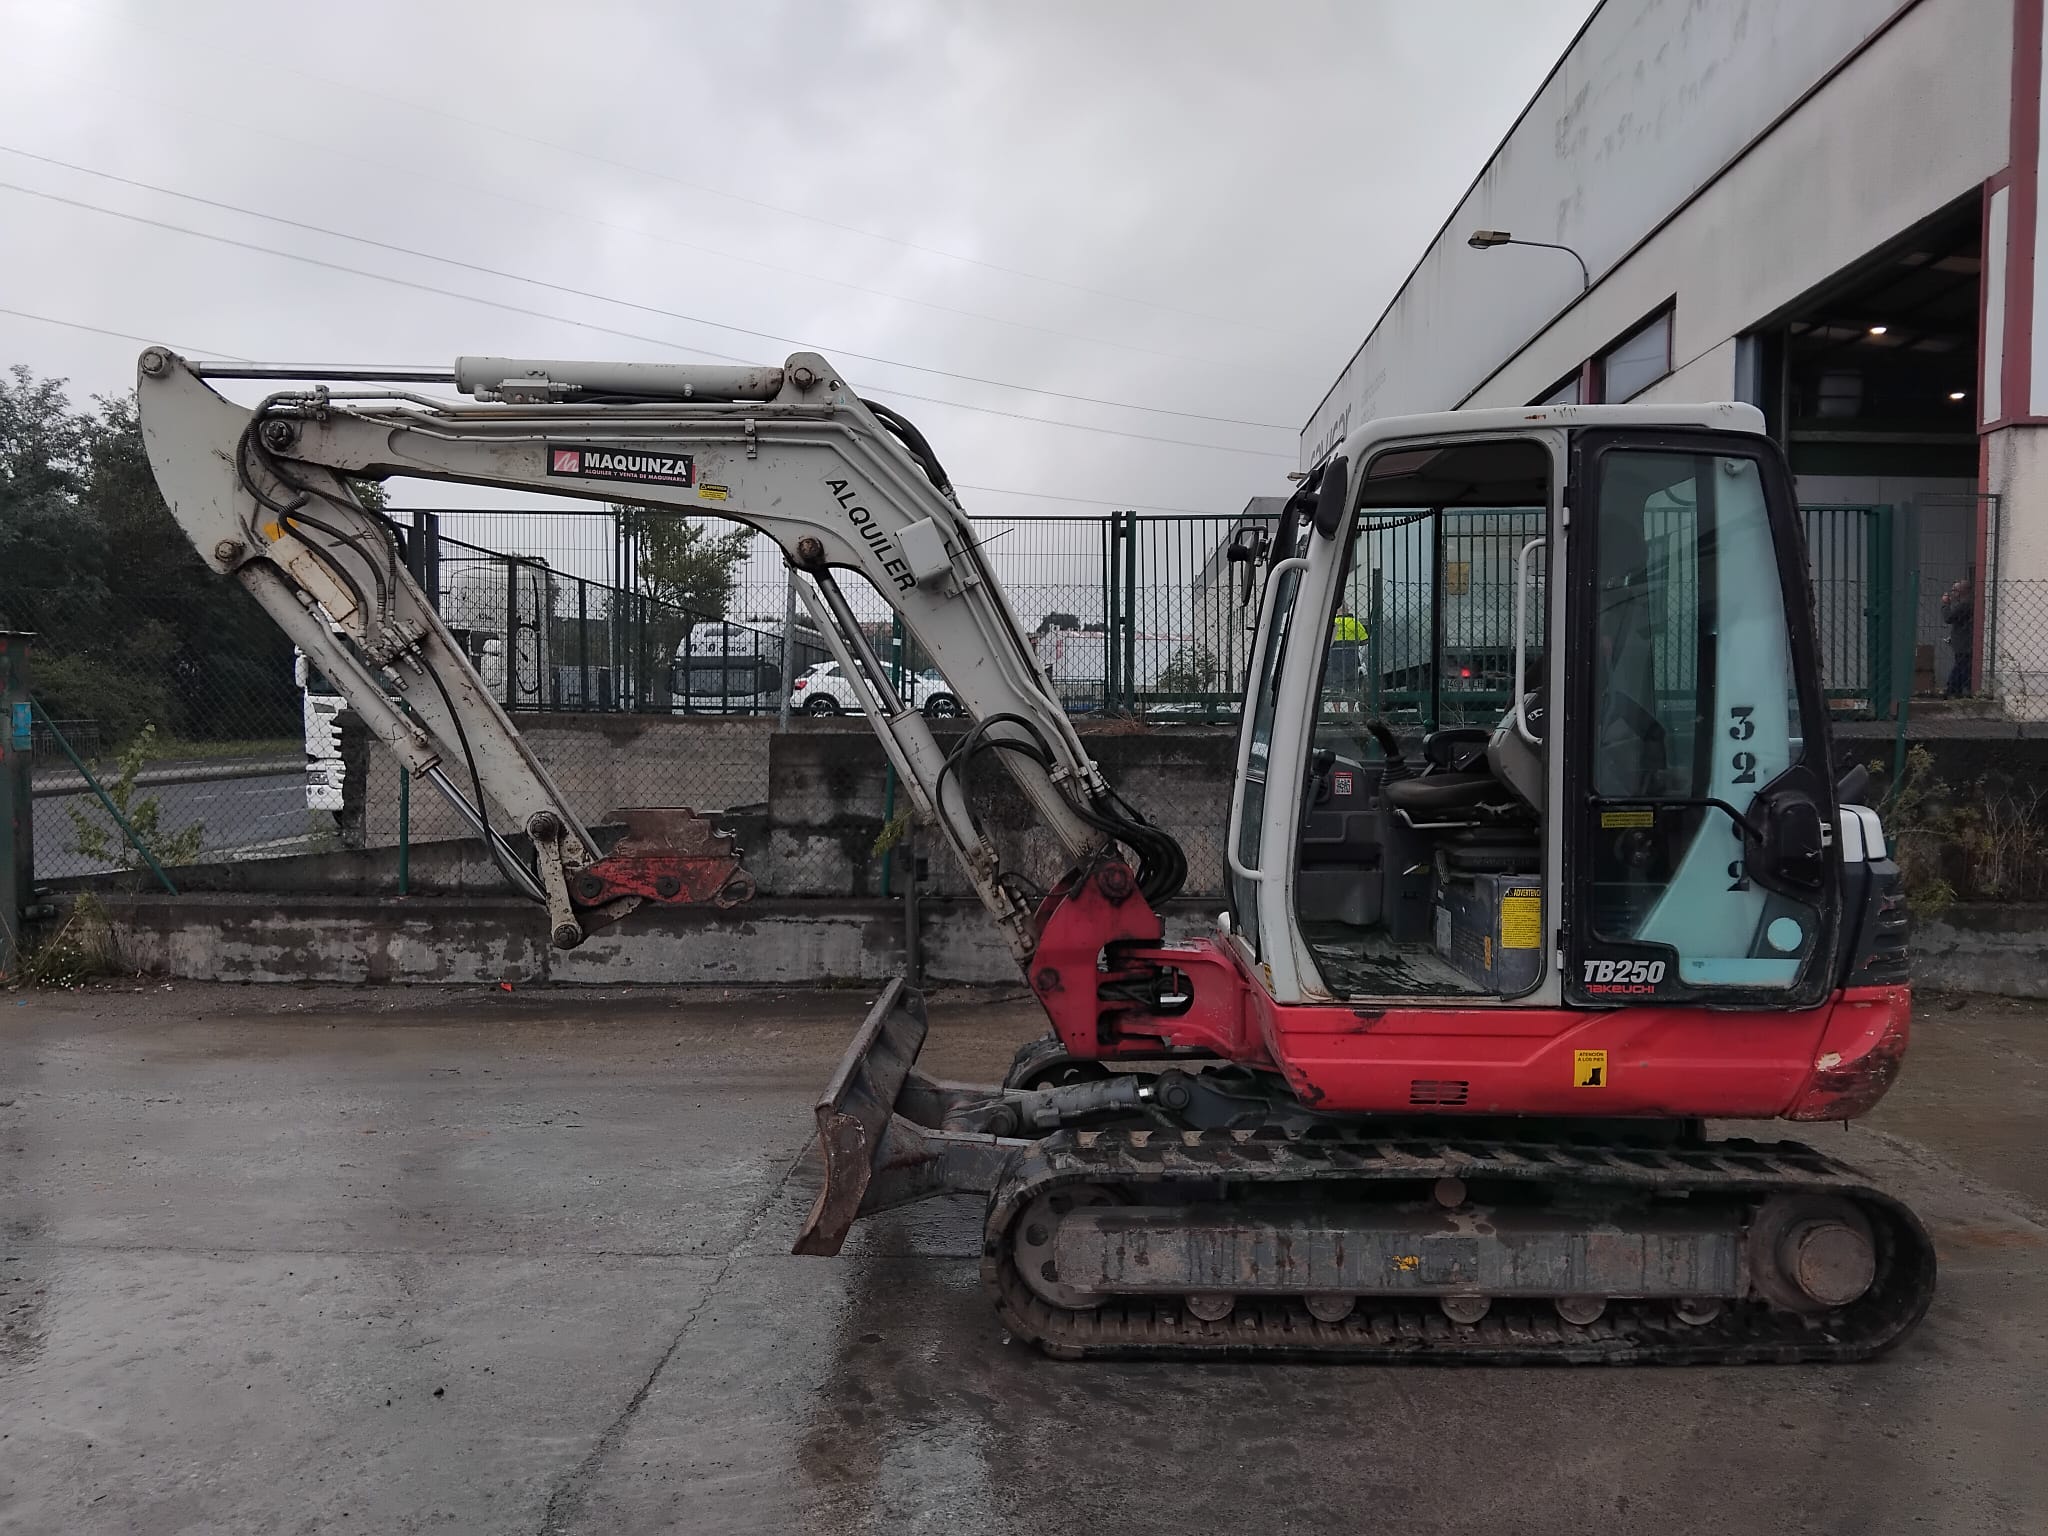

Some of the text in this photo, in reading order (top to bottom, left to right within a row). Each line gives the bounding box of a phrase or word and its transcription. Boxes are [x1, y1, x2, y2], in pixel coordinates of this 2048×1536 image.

[584, 453, 688, 475] MAQUINZA
[649, 474, 686, 482] MAQUINARIA
[825, 480, 917, 592] ALQUILER
[1583, 960, 1666, 983] TB250
[1585, 984, 1655, 994] TAKEUCHI
